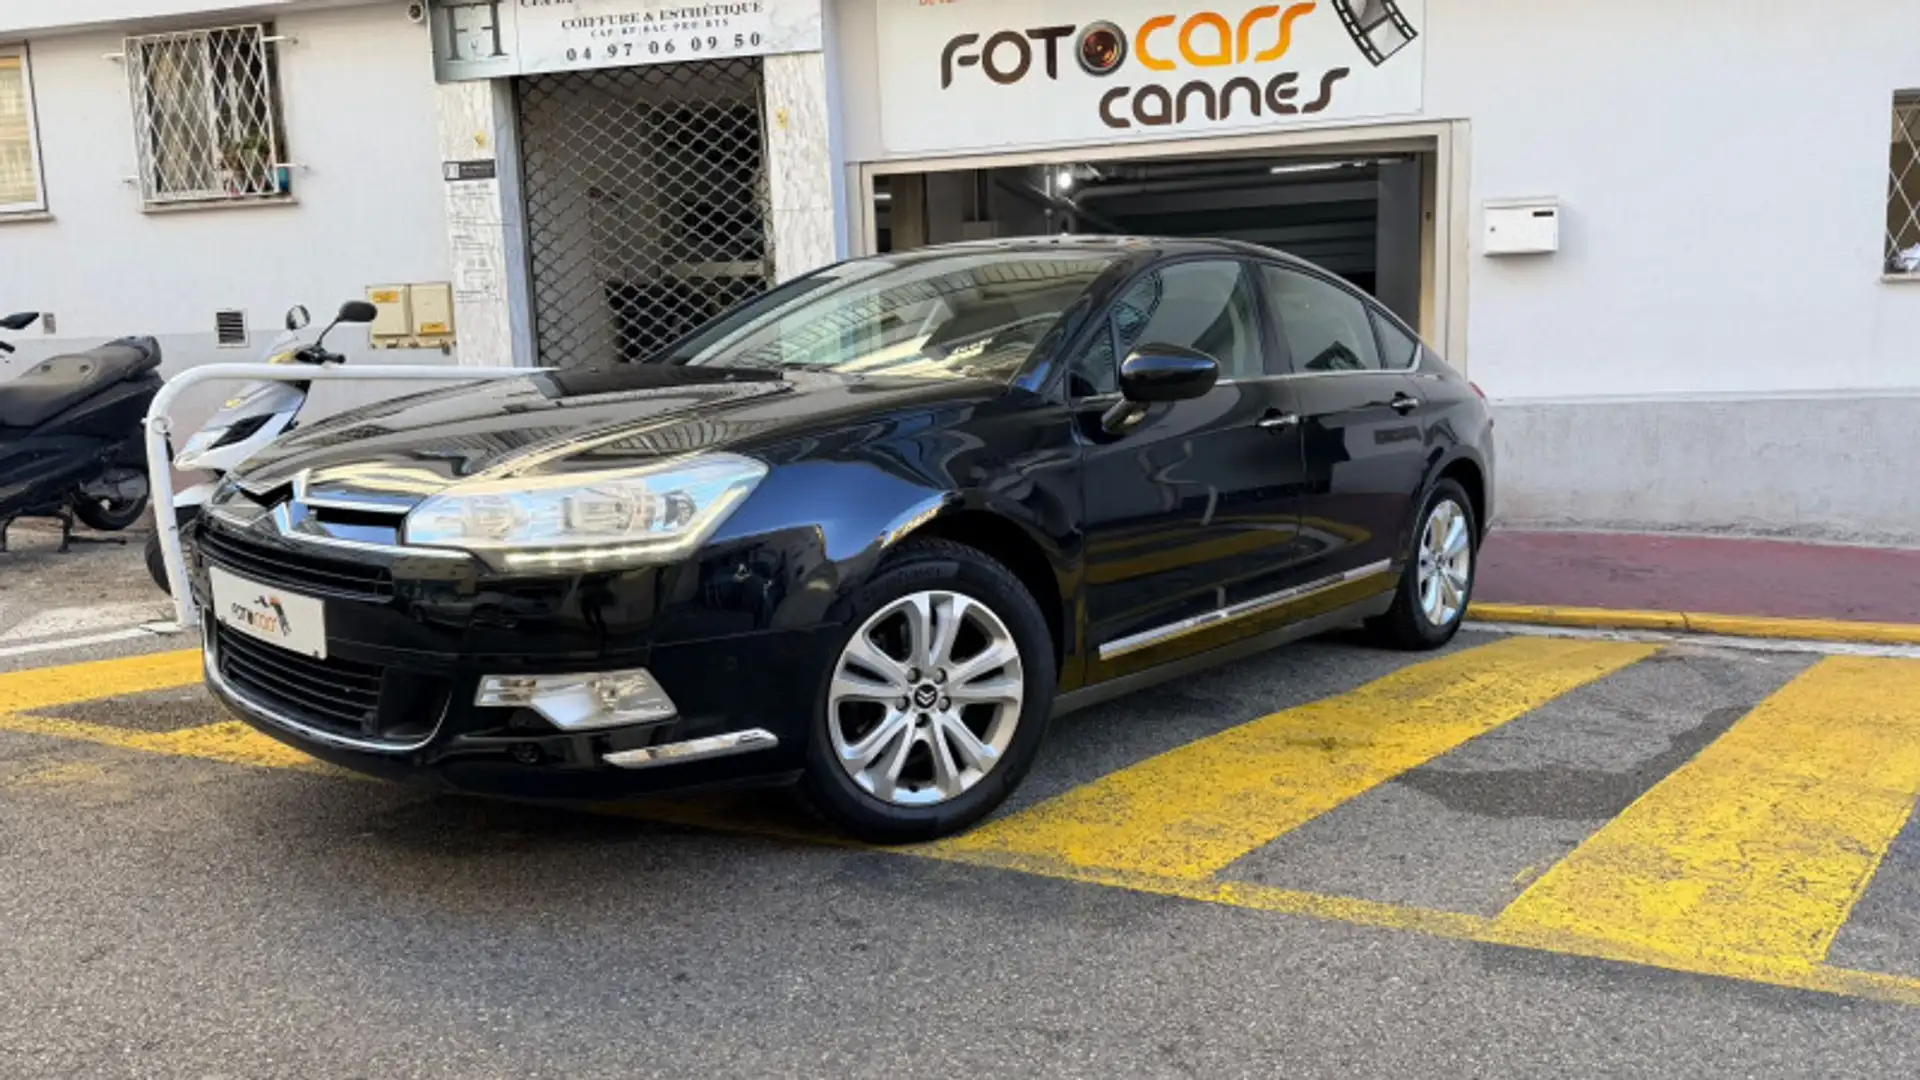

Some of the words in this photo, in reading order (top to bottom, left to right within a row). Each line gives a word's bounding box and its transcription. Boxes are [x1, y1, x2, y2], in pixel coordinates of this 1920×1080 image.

[561, 12, 640, 29] COIFFURE
[660, 2, 764, 21] ESTHÉTIQUE
[566, 47, 592, 61] 04
[607, 42, 633, 58] 97
[648, 39, 675, 55] 06
[691, 36, 718, 52] 09
[734, 31, 761, 48] 50
